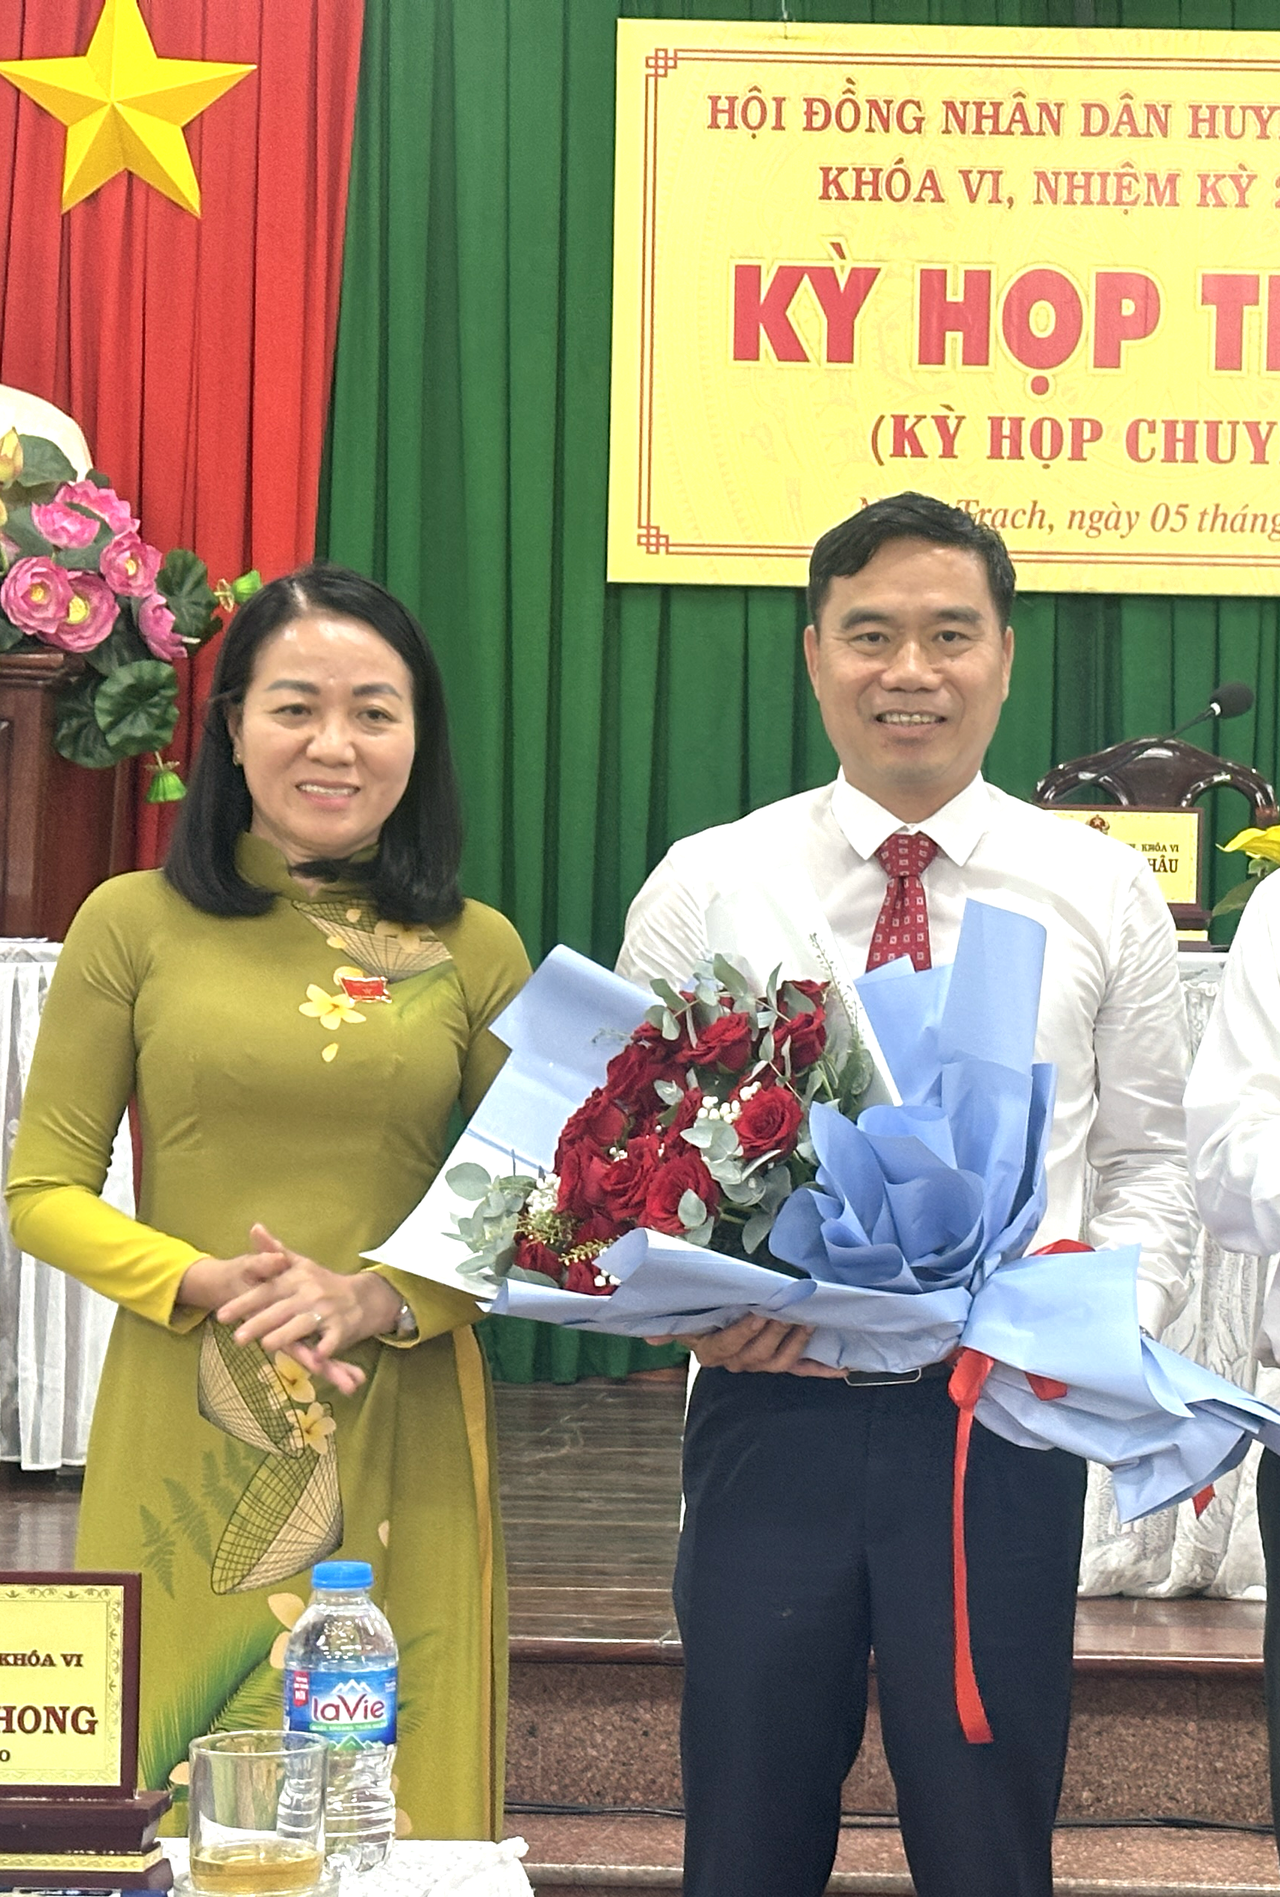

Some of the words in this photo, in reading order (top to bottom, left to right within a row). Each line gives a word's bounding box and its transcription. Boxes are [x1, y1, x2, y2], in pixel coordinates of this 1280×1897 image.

[706, 85, 787, 140] HỘI
[802, 77, 926, 135] ĐỒNG
[941, 91, 1065, 137] NHÂN
[1080, 92, 1173, 139] DÂN
[818, 157, 946, 204] KHÓA
[957, 169, 1014, 210] VI,
[1032, 161, 1181, 216] NHIỆM
[1196, 162, 1258, 209] KỲ
[732, 241, 882, 364] KỲ
[917, 268, 1161, 396] HỌP
[871, 404, 967, 467] (KỲ
[986, 415, 1104, 470] HỌP
[1067, 501, 1140, 539] ngày
[1150, 502, 1190, 533] 05
[1169, 844, 1179, 853] VI
[60, 1653, 84, 1668] VI
[312, 1693, 385, 1722] laVie
